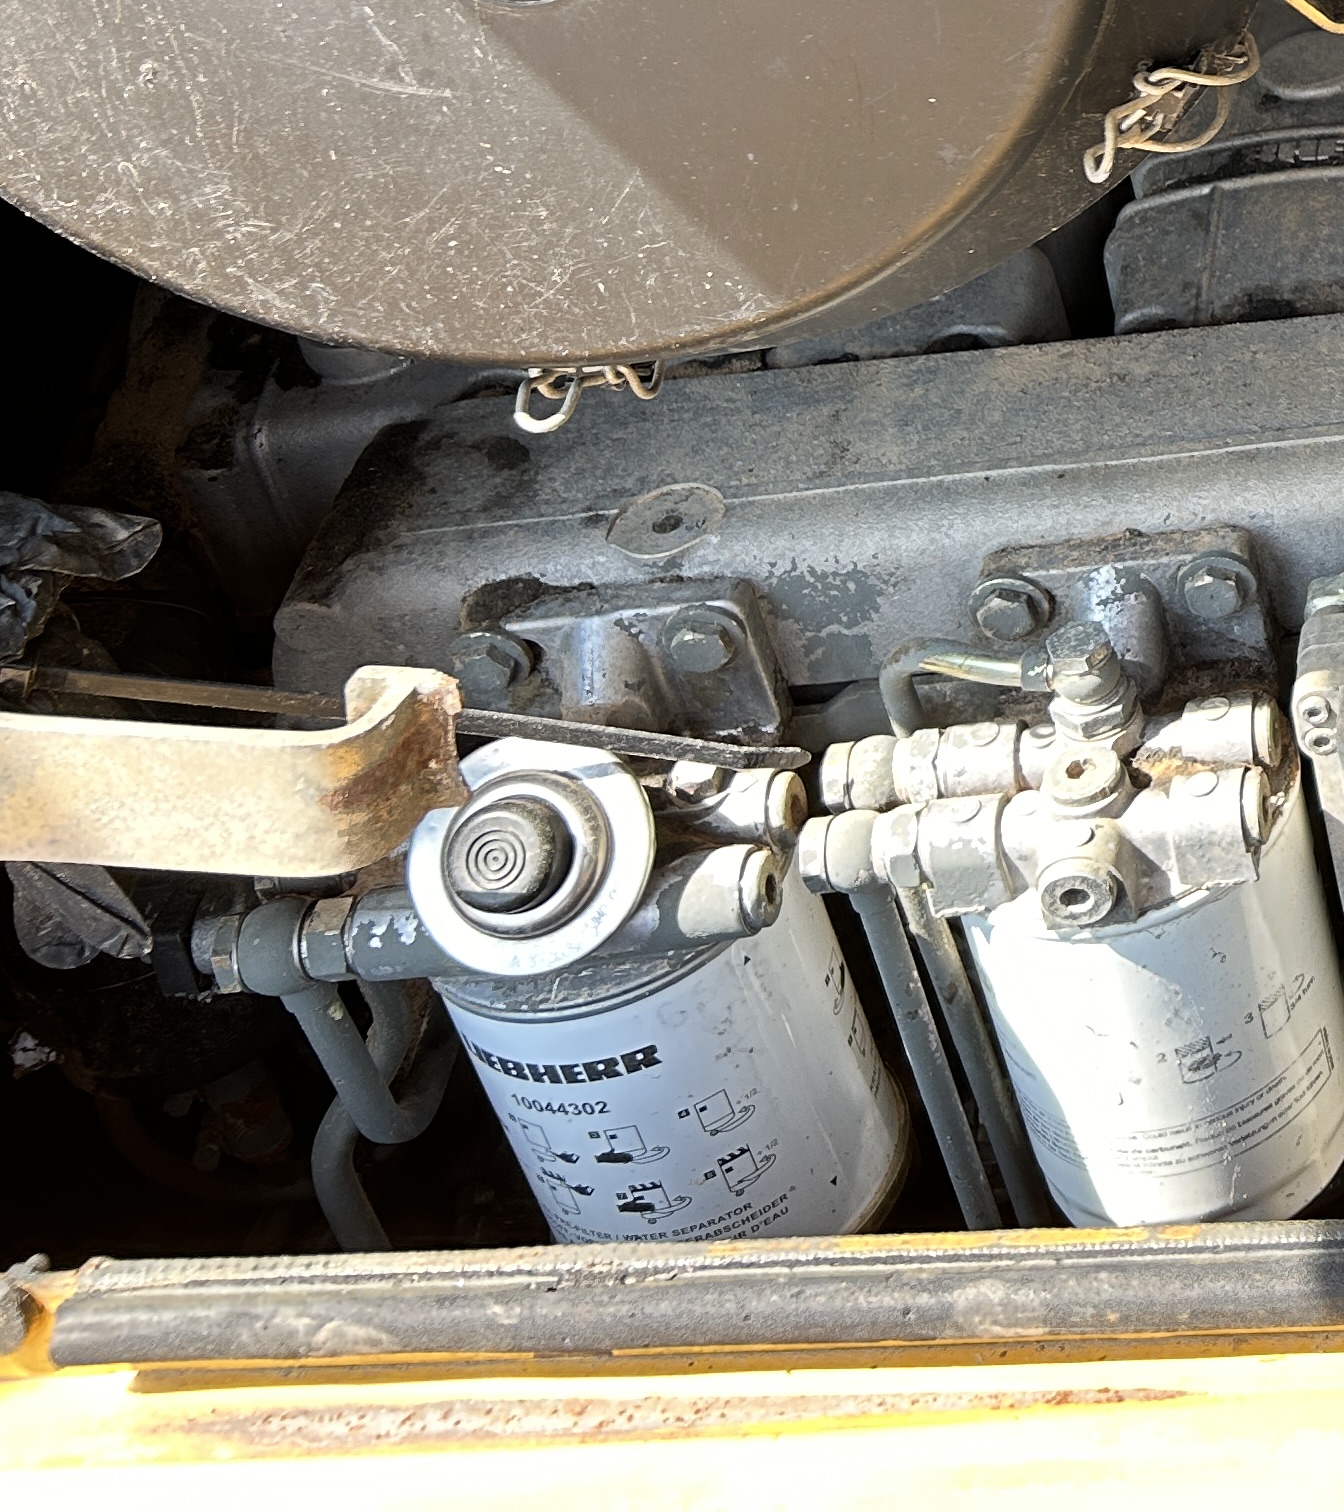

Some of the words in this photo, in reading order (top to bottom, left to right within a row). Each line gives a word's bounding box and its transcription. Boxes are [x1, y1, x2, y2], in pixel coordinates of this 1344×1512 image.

[511, 1093, 611, 1116] 10044302
[622, 1231, 669, 1242] WATER
[671, 1201, 753, 1238] SEPARATOR
[751, 1206, 790, 1234] D'EAU
